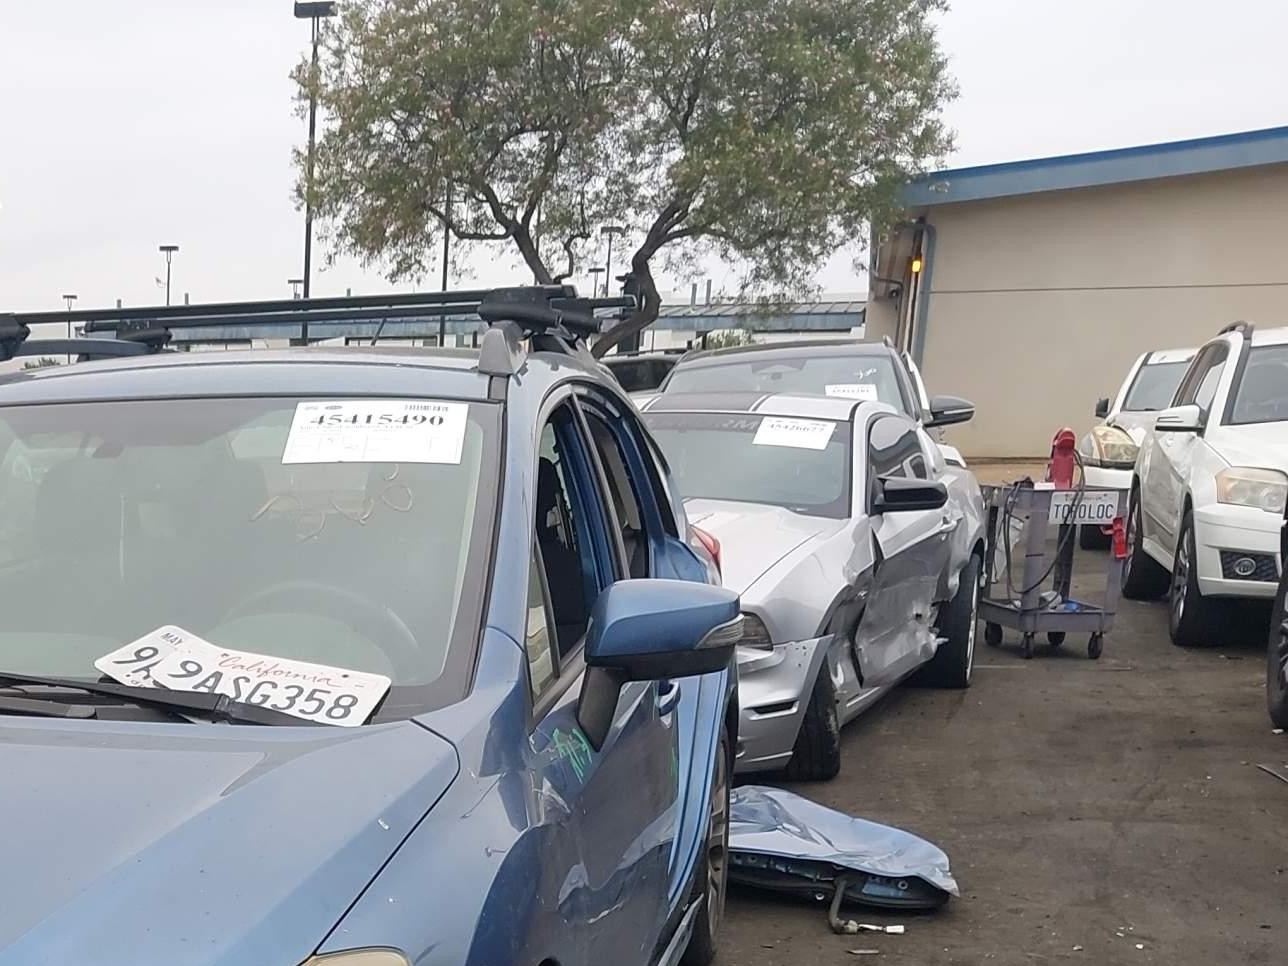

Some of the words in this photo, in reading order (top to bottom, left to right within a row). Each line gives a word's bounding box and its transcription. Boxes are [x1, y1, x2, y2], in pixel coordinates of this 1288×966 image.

[310, 413, 445, 426] 45415490
[161, 631, 183, 646] MAY
[219, 654, 343, 687] California
[167, 660, 359, 720] 9ASG358
